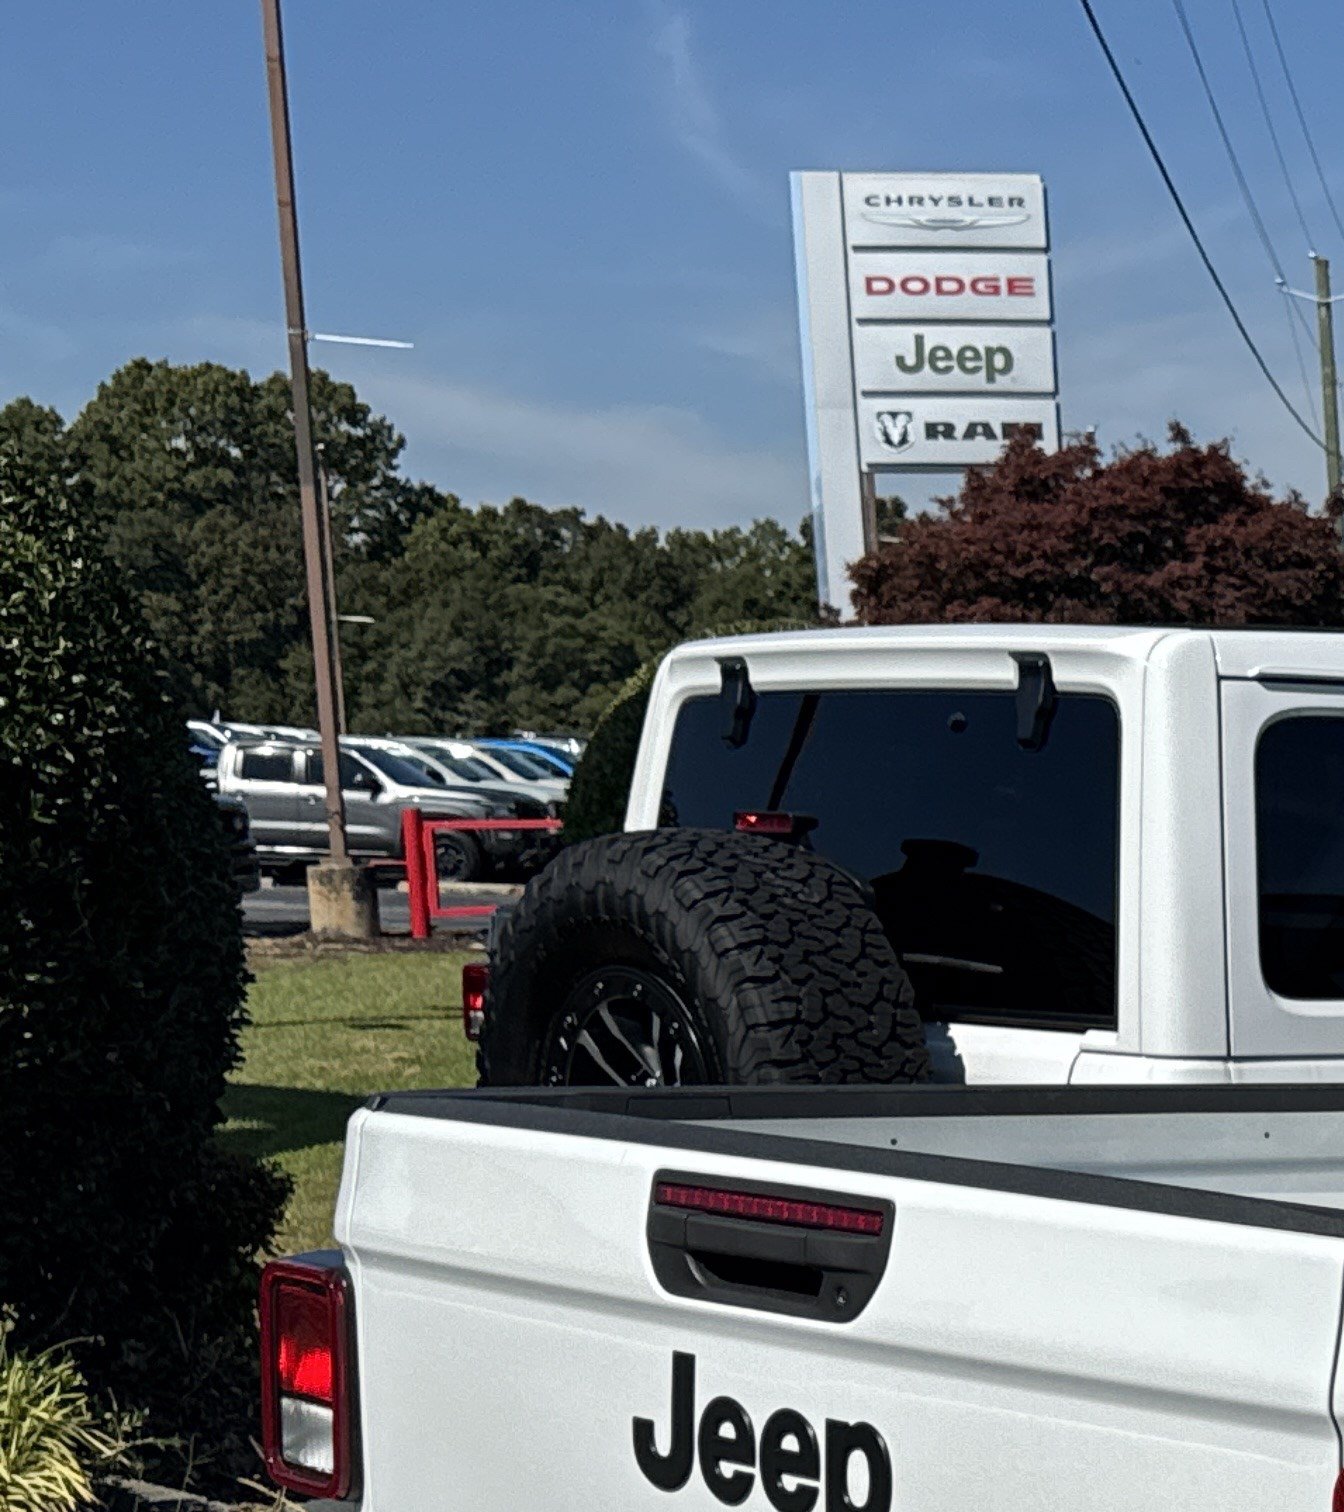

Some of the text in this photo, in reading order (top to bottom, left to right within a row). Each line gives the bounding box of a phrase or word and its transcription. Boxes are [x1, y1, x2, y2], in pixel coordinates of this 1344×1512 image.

[864, 194, 1026, 209] CHRYSLER
[865, 275, 1037, 297] DODGE
[895, 333, 1015, 383] Jeep
